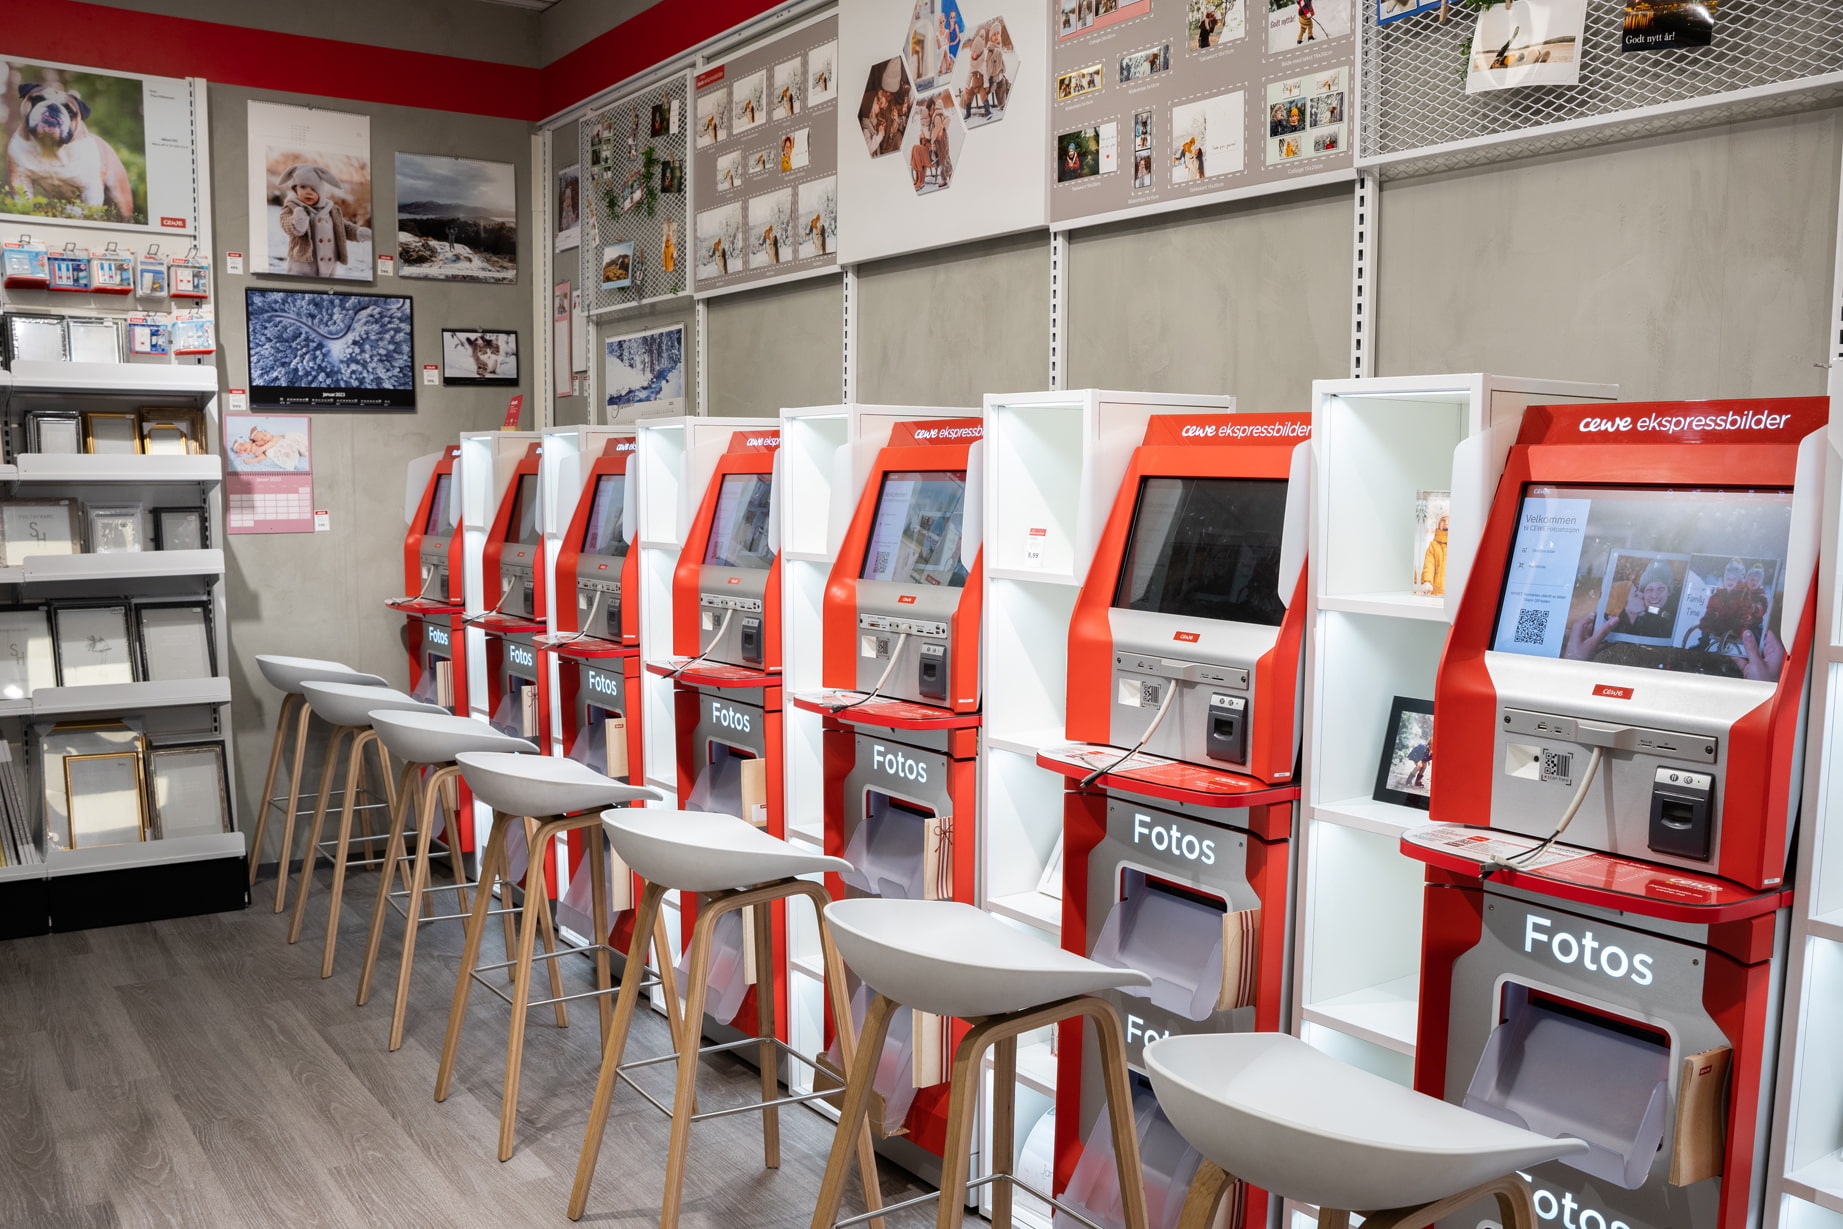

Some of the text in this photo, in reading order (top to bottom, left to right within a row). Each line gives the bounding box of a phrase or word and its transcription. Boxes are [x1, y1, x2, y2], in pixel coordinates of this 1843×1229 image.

[1625, 31, 1675, 45] Godt nytt år!
[1181, 421, 1312, 440] cewe ekspressbilder
[1579, 410, 1791, 434] cewe ekspressbilder
[914, 429, 938, 439] cewe
[1525, 513, 1577, 526] Velkommen
[428, 626, 449, 646] Fotos
[509, 645, 533, 667] Fotos
[588, 670, 617, 696] Fotos
[1602, 688, 1624, 697] cewe
[712, 702, 750, 733] Fotos
[873, 744, 927, 783] Fotos
[1134, 813, 1215, 865] Fotos
[1524, 914, 1653, 986] Fotos
[1515, 1170, 1631, 1229] oto
